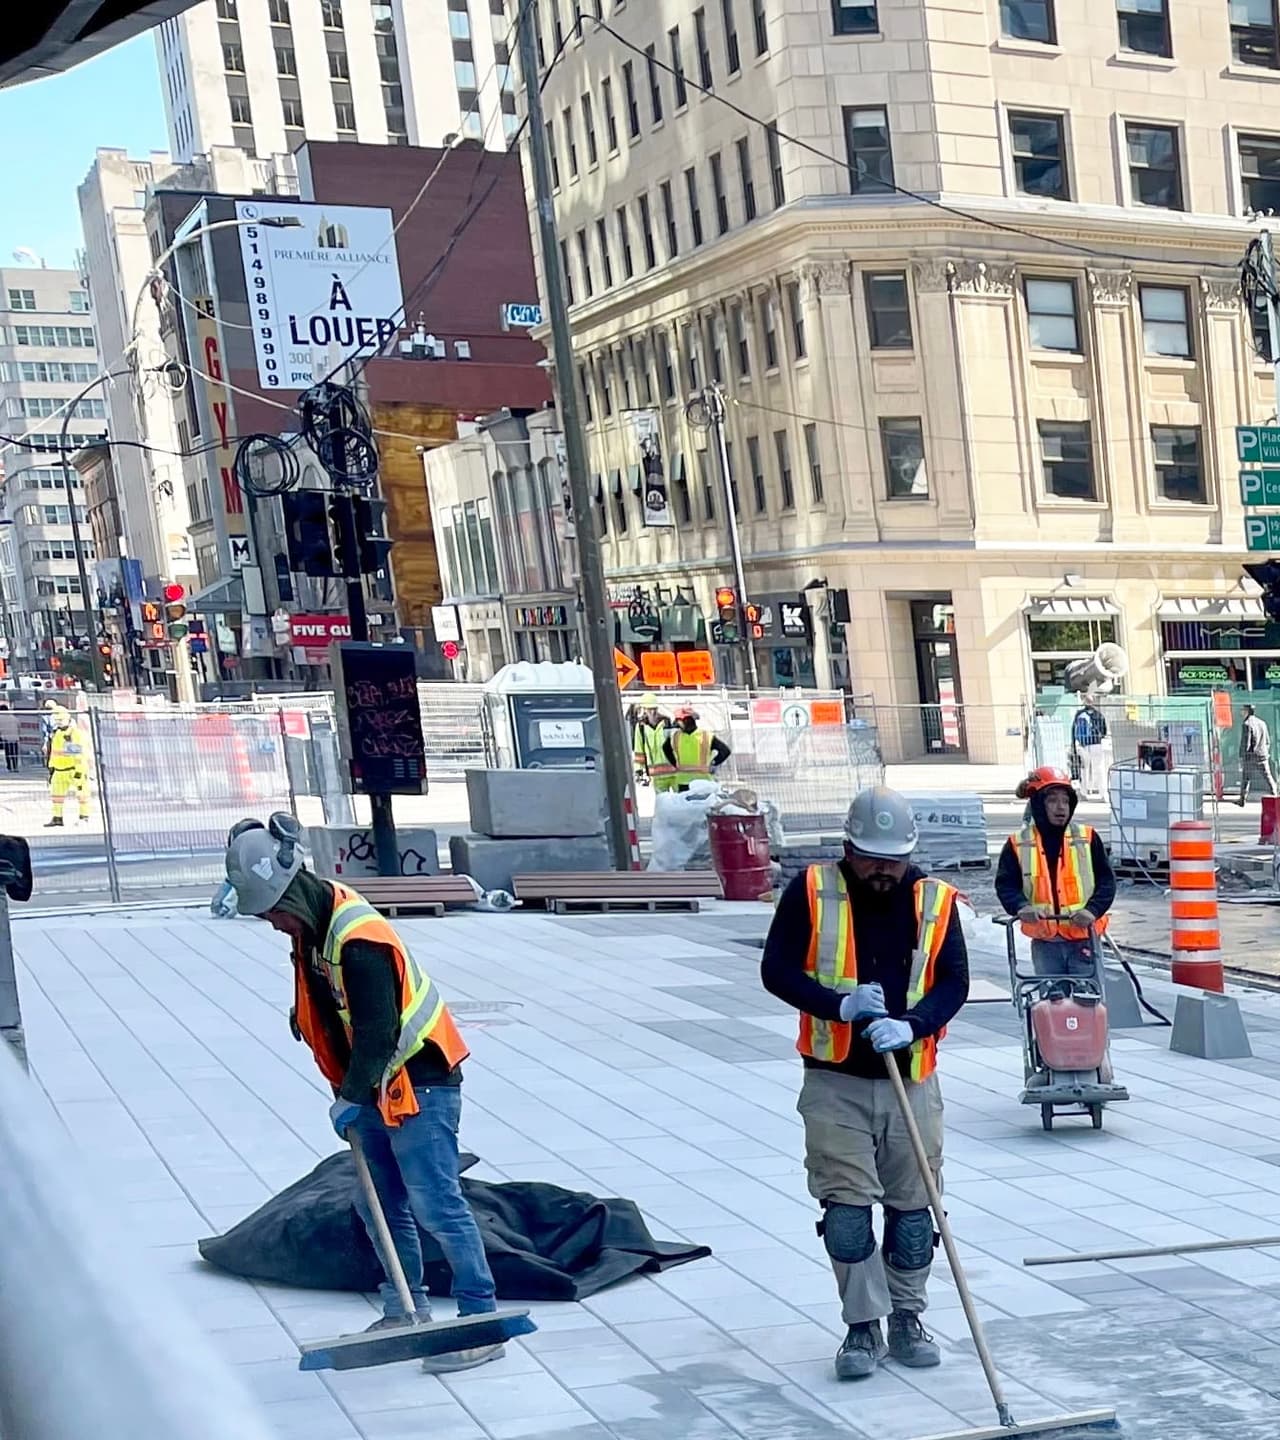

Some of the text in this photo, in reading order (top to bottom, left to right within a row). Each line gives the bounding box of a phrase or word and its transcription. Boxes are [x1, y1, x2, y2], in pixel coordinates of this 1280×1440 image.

[335, 250, 392, 264] ALLIANCE
[329, 273, 353, 311] À
[205, 337, 243, 514] GYM
[293, 624, 351, 636] FIVE GU
